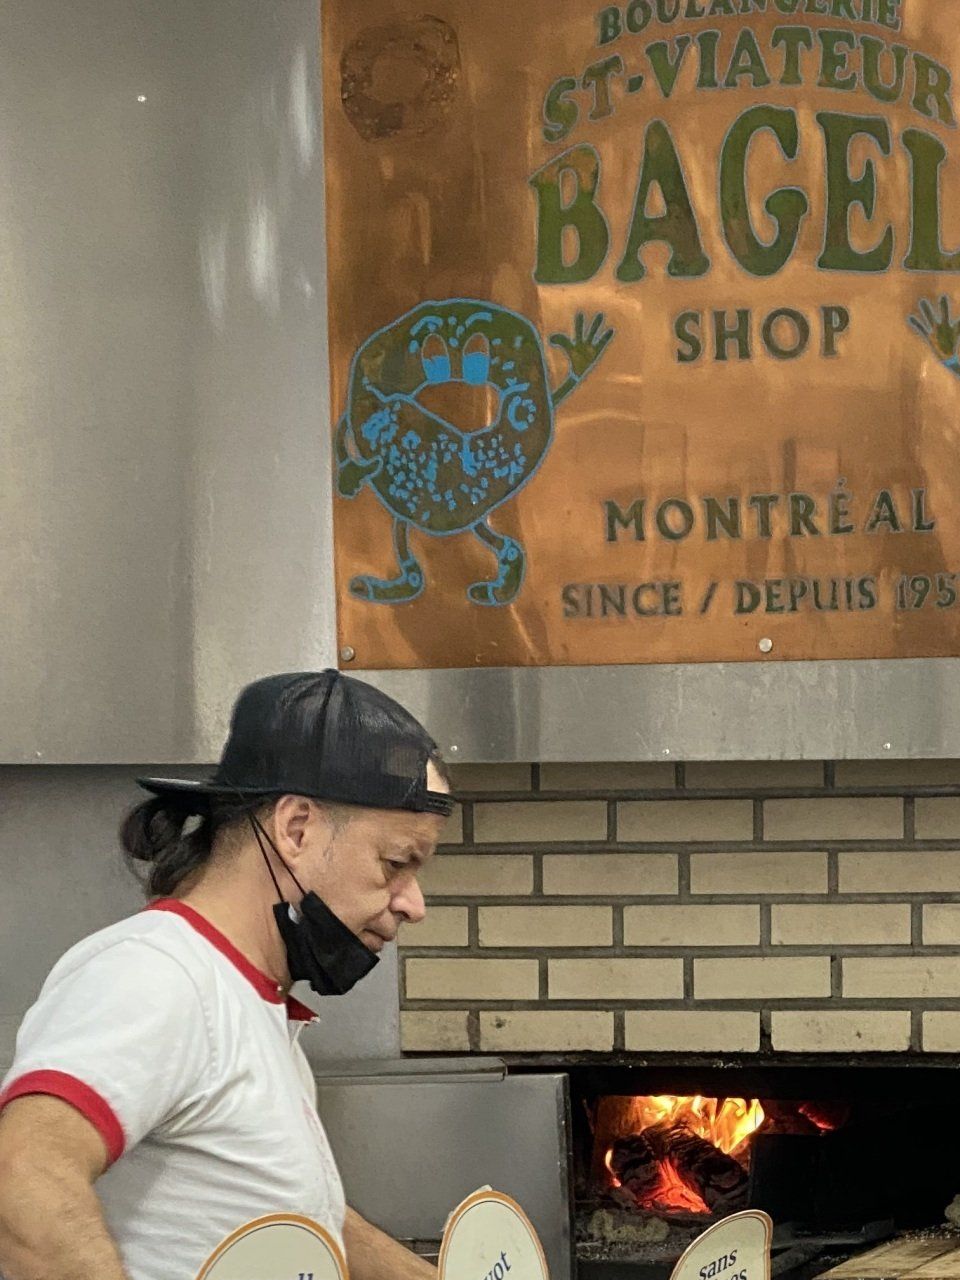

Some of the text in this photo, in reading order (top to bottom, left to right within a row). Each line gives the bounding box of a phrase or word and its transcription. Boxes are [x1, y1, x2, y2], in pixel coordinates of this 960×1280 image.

[542, 26, 957, 143] ST-VIATEUR
[673, 305, 850, 363] SHOP
[604, 478, 936, 543] MONTRÉAL
[561, 581, 683, 619] SINCE
[734, 575, 879, 615] DEPUIS
